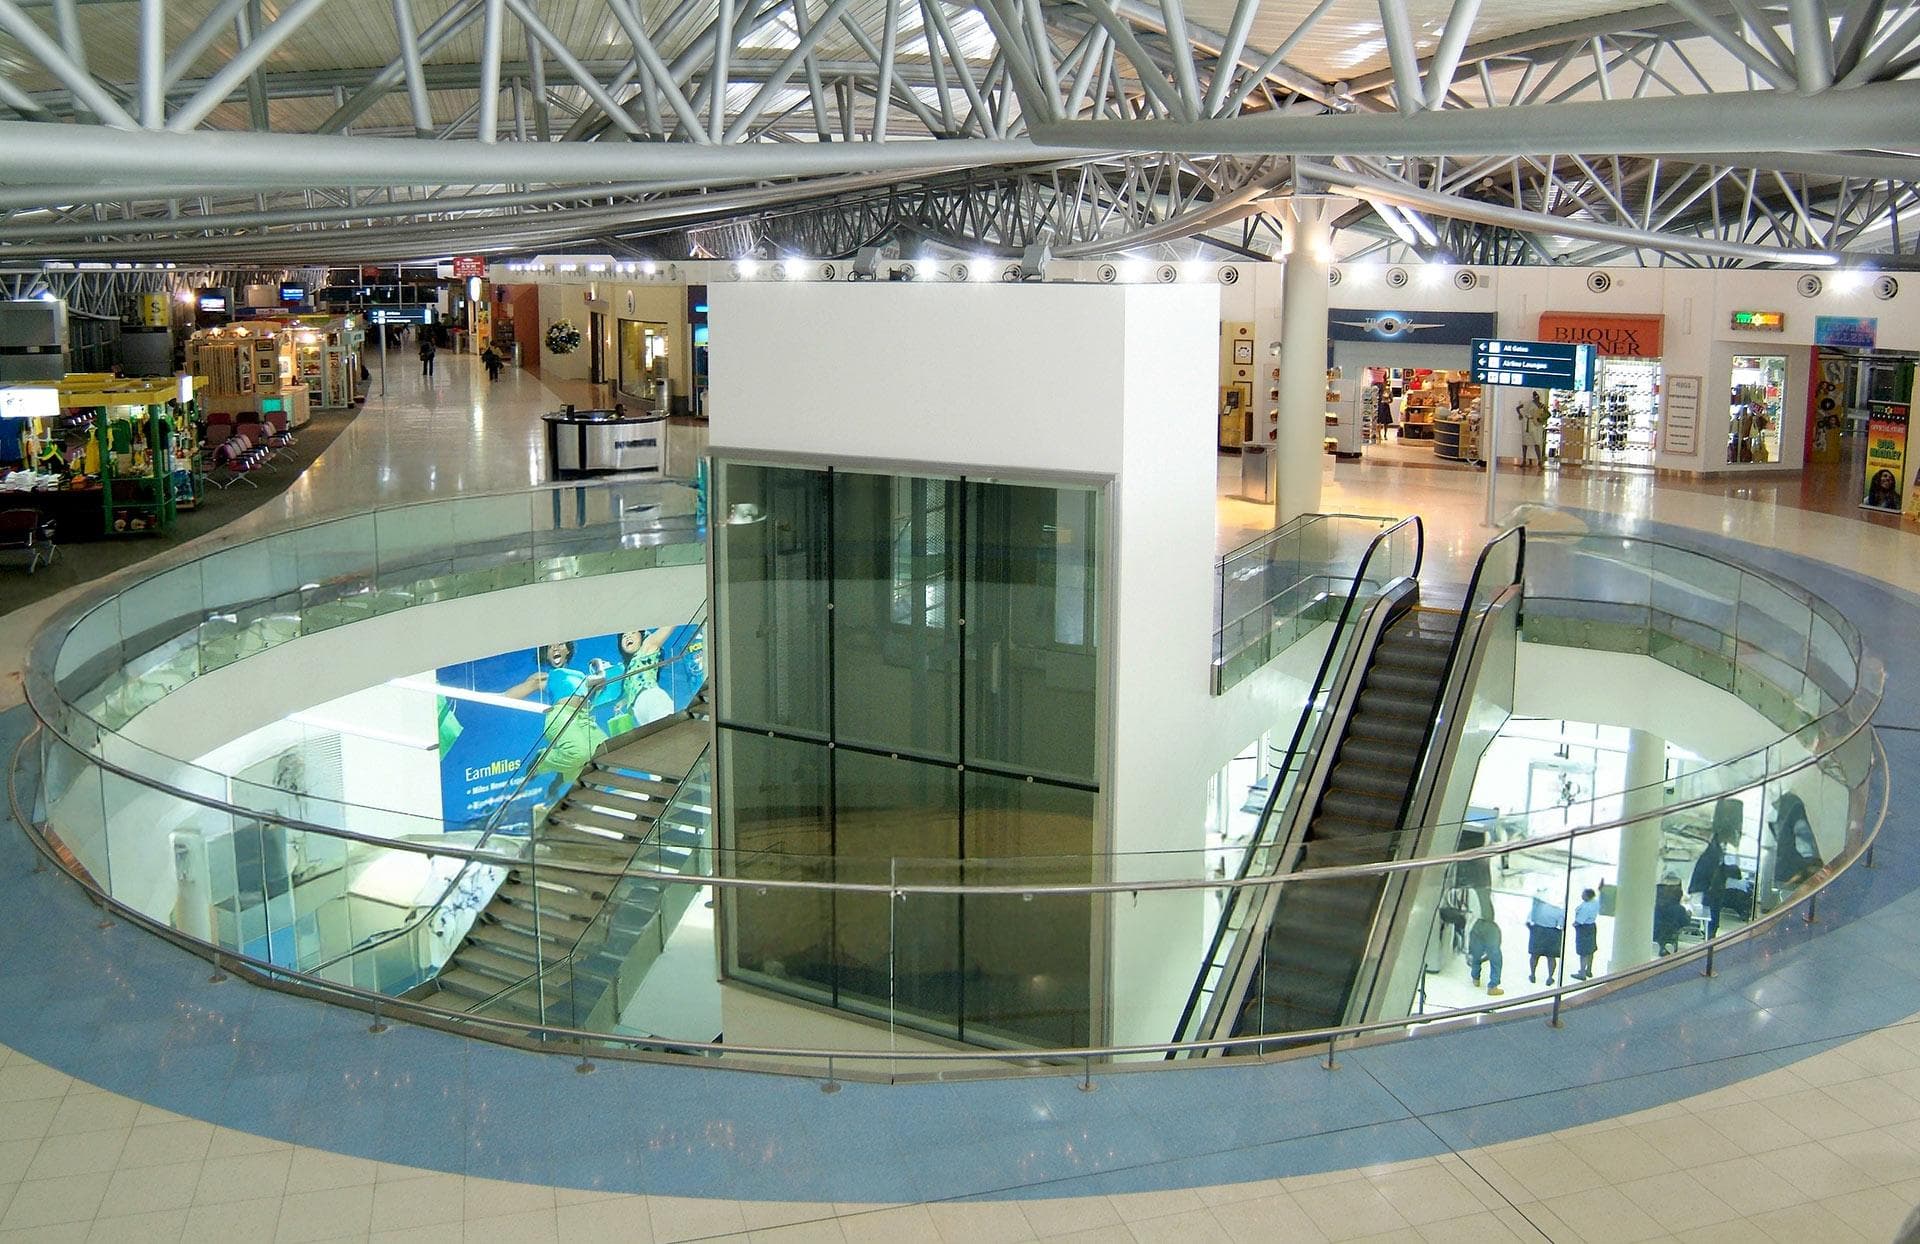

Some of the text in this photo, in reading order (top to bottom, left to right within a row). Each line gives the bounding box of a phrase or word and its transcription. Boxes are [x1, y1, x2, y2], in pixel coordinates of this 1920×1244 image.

[1555, 327, 1638, 342] BIJOUX
[1512, 345, 1529, 353] Gates
[1522, 361, 1548, 370] Lounges
[465, 759, 521, 782] EarnMiles
